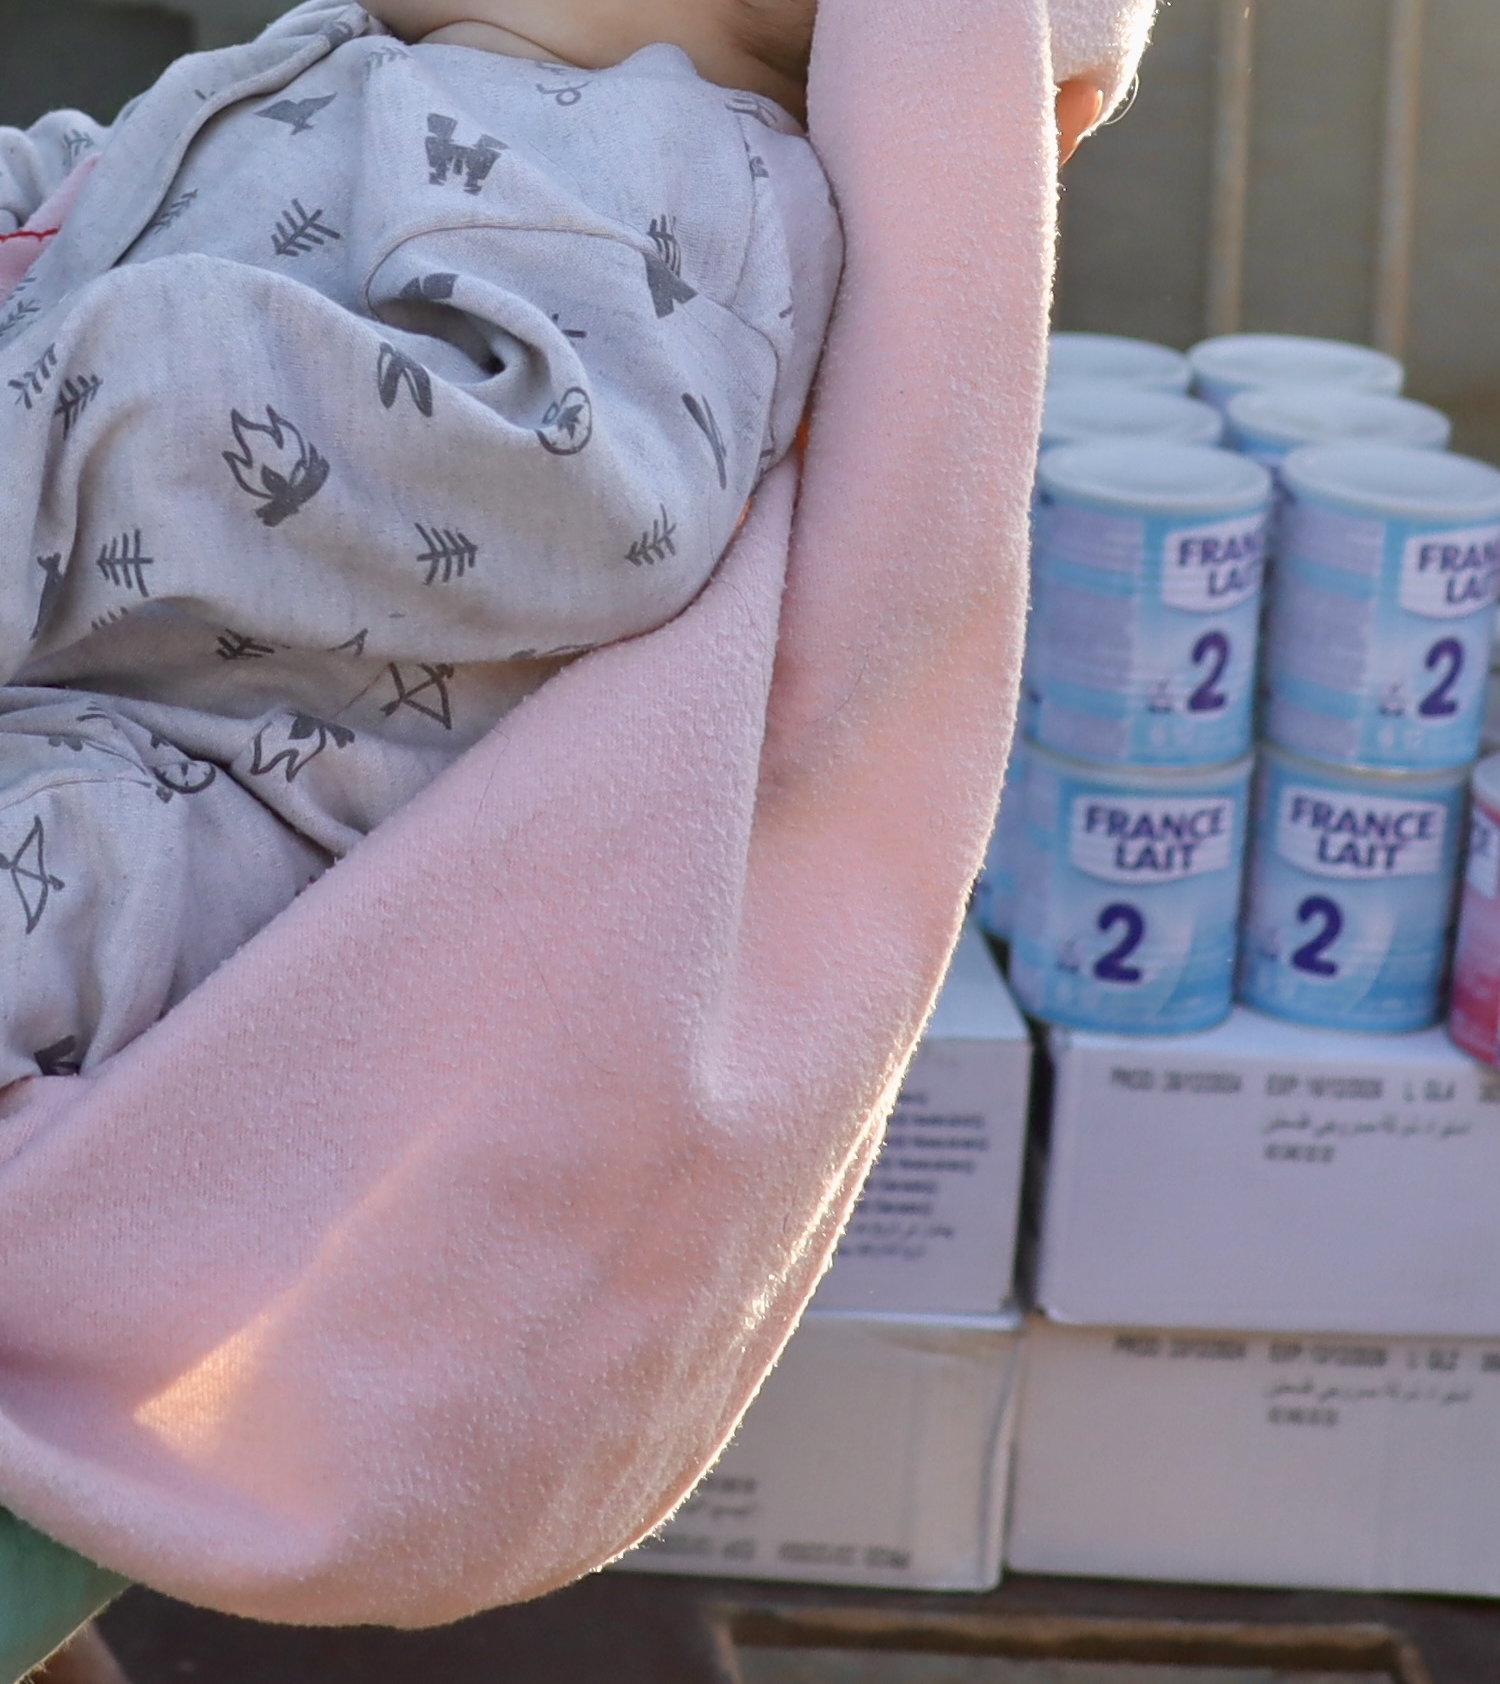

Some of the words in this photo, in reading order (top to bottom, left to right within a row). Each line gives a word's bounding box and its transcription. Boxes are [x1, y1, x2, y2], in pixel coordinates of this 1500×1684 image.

[1187, 631, 1231, 712] 2
[1418, 637, 1465, 716] 2
[1083, 804, 1228, 842] FRANCE
[1290, 796, 1434, 840] FRANCE
[1113, 837, 1198, 873] LAIT
[1317, 835, 1403, 871] LAIT
[1092, 901, 1146, 984] 2
[1292, 894, 1343, 977] 2
